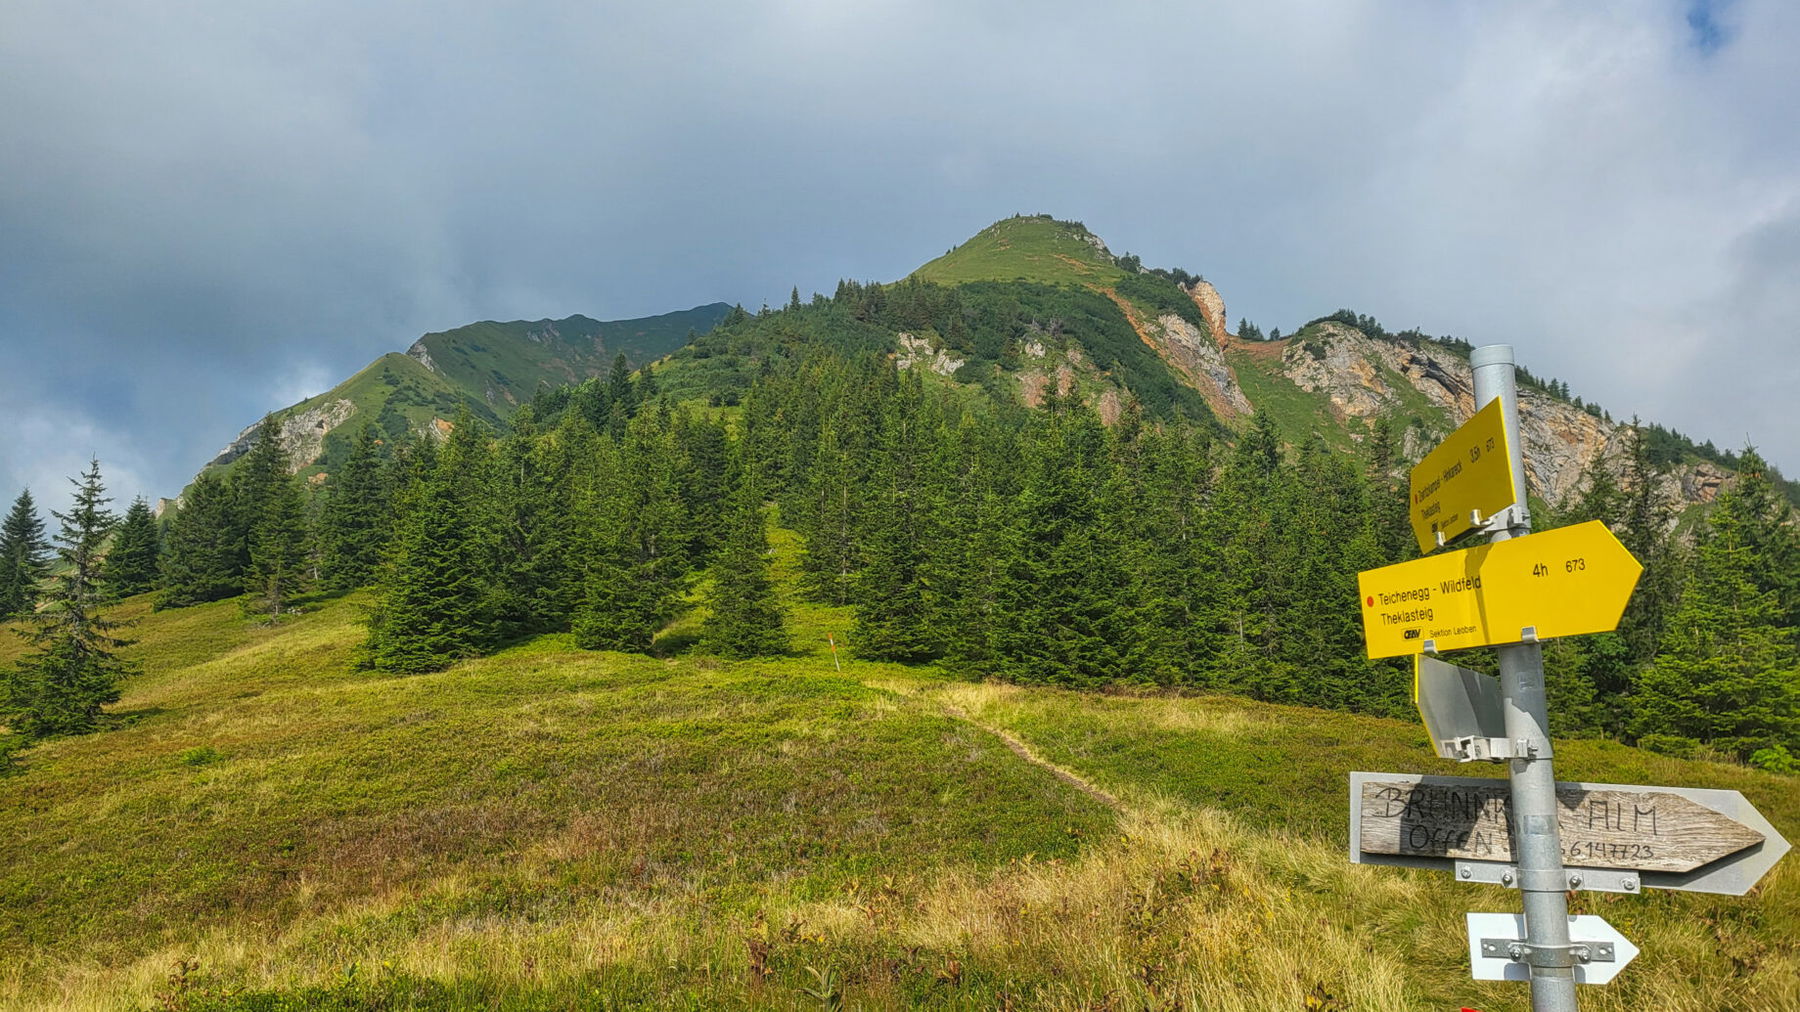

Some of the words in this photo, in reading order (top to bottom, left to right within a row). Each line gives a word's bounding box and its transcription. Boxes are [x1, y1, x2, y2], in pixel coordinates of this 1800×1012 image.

[1378, 587, 1430, 606] Teichenegg
[1440, 575, 1481, 595] Wildfeld
[1533, 562, 1549, 578] 4h
[1565, 557, 1586, 573] 673
[1381, 608, 1434, 626] Theklasteig
[1429, 629, 1452, 638] Sektion
[1453, 625, 1477, 636] Leoben
[1589, 800, 1658, 836] ALM
